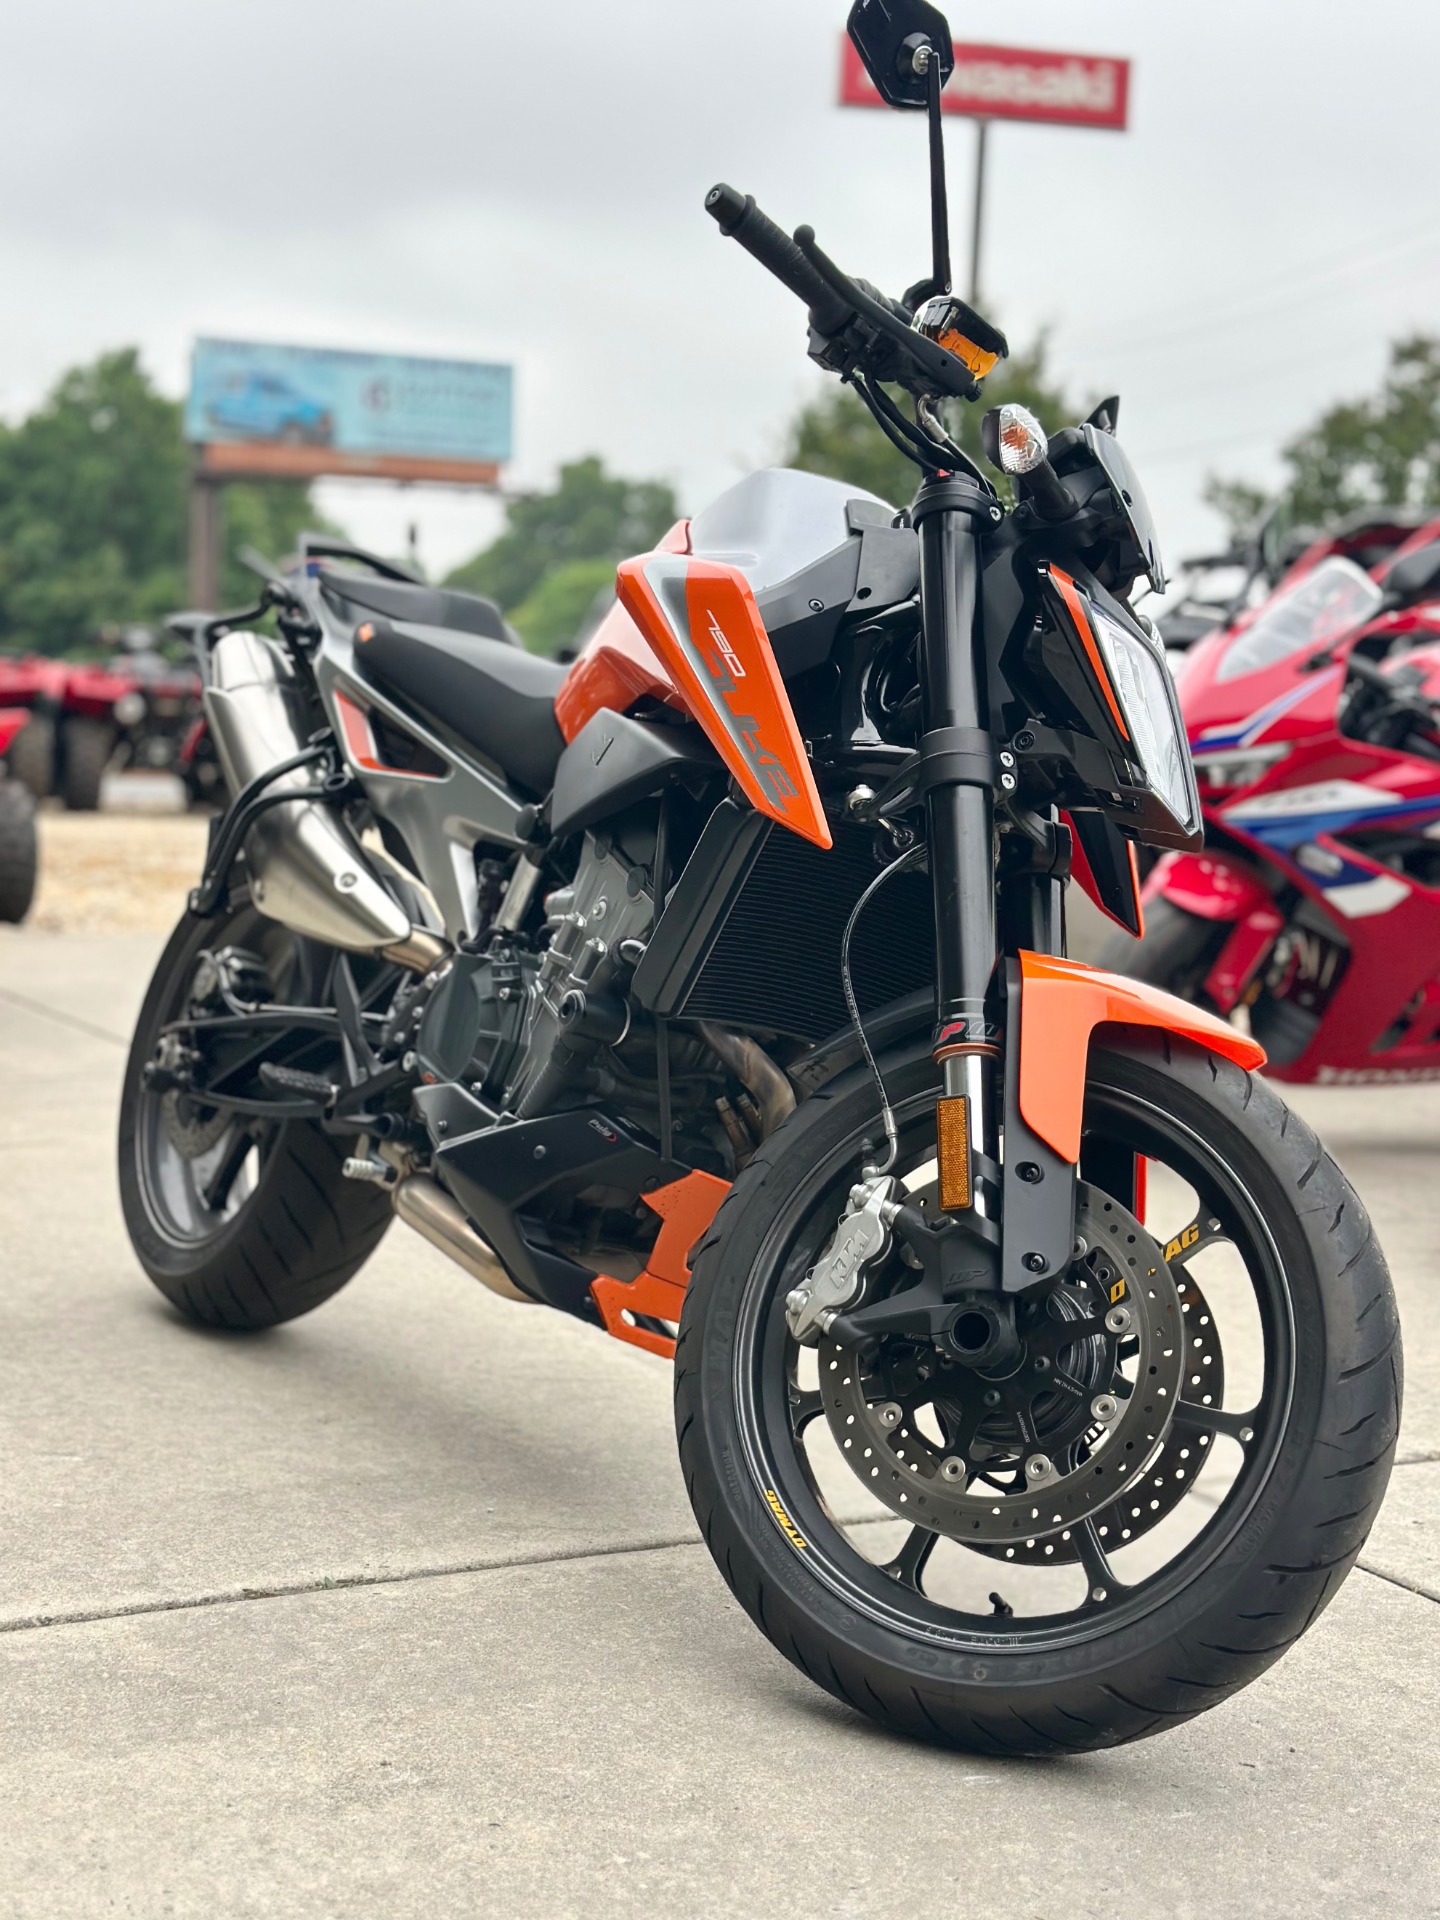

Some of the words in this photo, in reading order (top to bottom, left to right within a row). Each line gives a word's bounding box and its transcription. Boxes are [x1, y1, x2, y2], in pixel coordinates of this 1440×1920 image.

[853, 57, 1119, 112] wasaki
[706, 609, 747, 677] 790
[699, 648, 799, 814] DUKE
[588, 1119, 613, 1137] Puig
[830, 1229, 870, 1290] KTM
[764, 1489, 807, 1549] DYMAG
